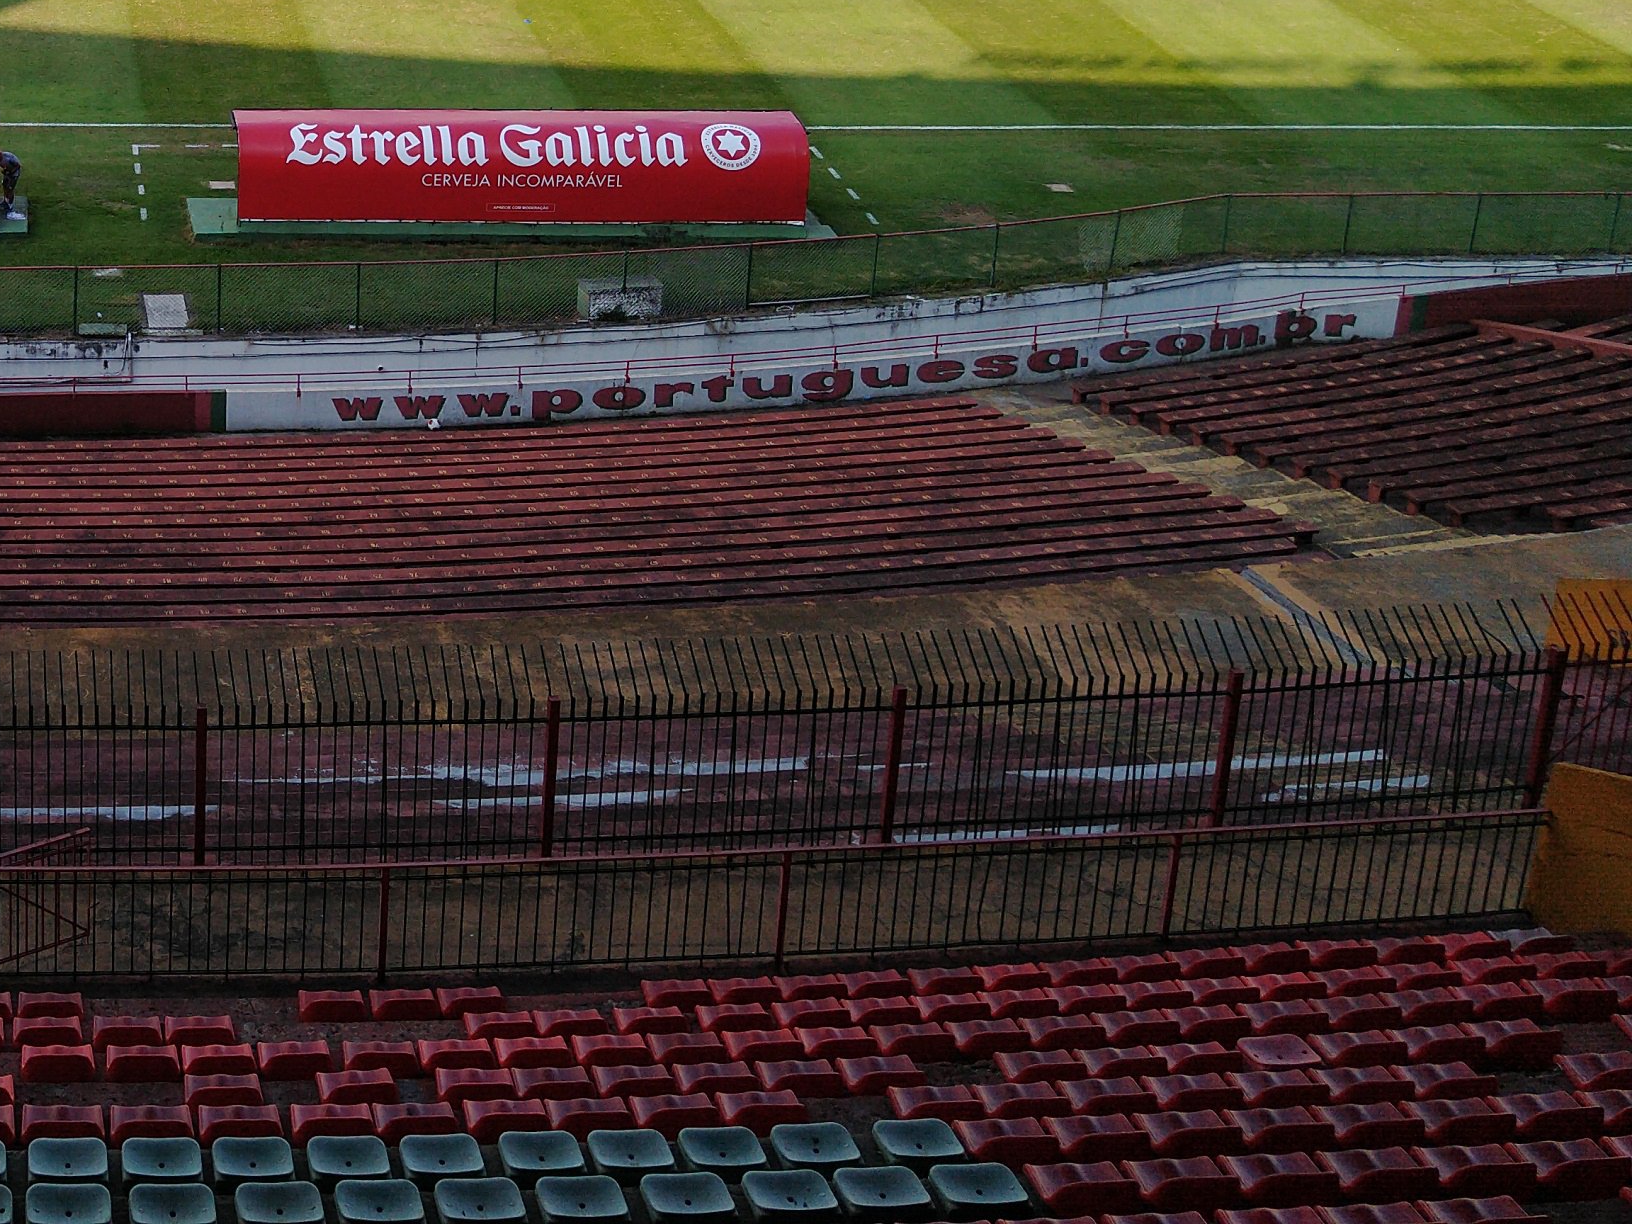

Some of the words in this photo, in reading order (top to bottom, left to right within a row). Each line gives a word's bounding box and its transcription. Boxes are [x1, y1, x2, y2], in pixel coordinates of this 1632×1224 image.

[286, 122, 488, 168] Estrella
[499, 123, 688, 168] Galicia
[421, 174, 491, 187] CERVEJA
[497, 172, 623, 188] INCOMPARÁVEL
[332, 311, 1356, 421] www.portuguesa.com.br
